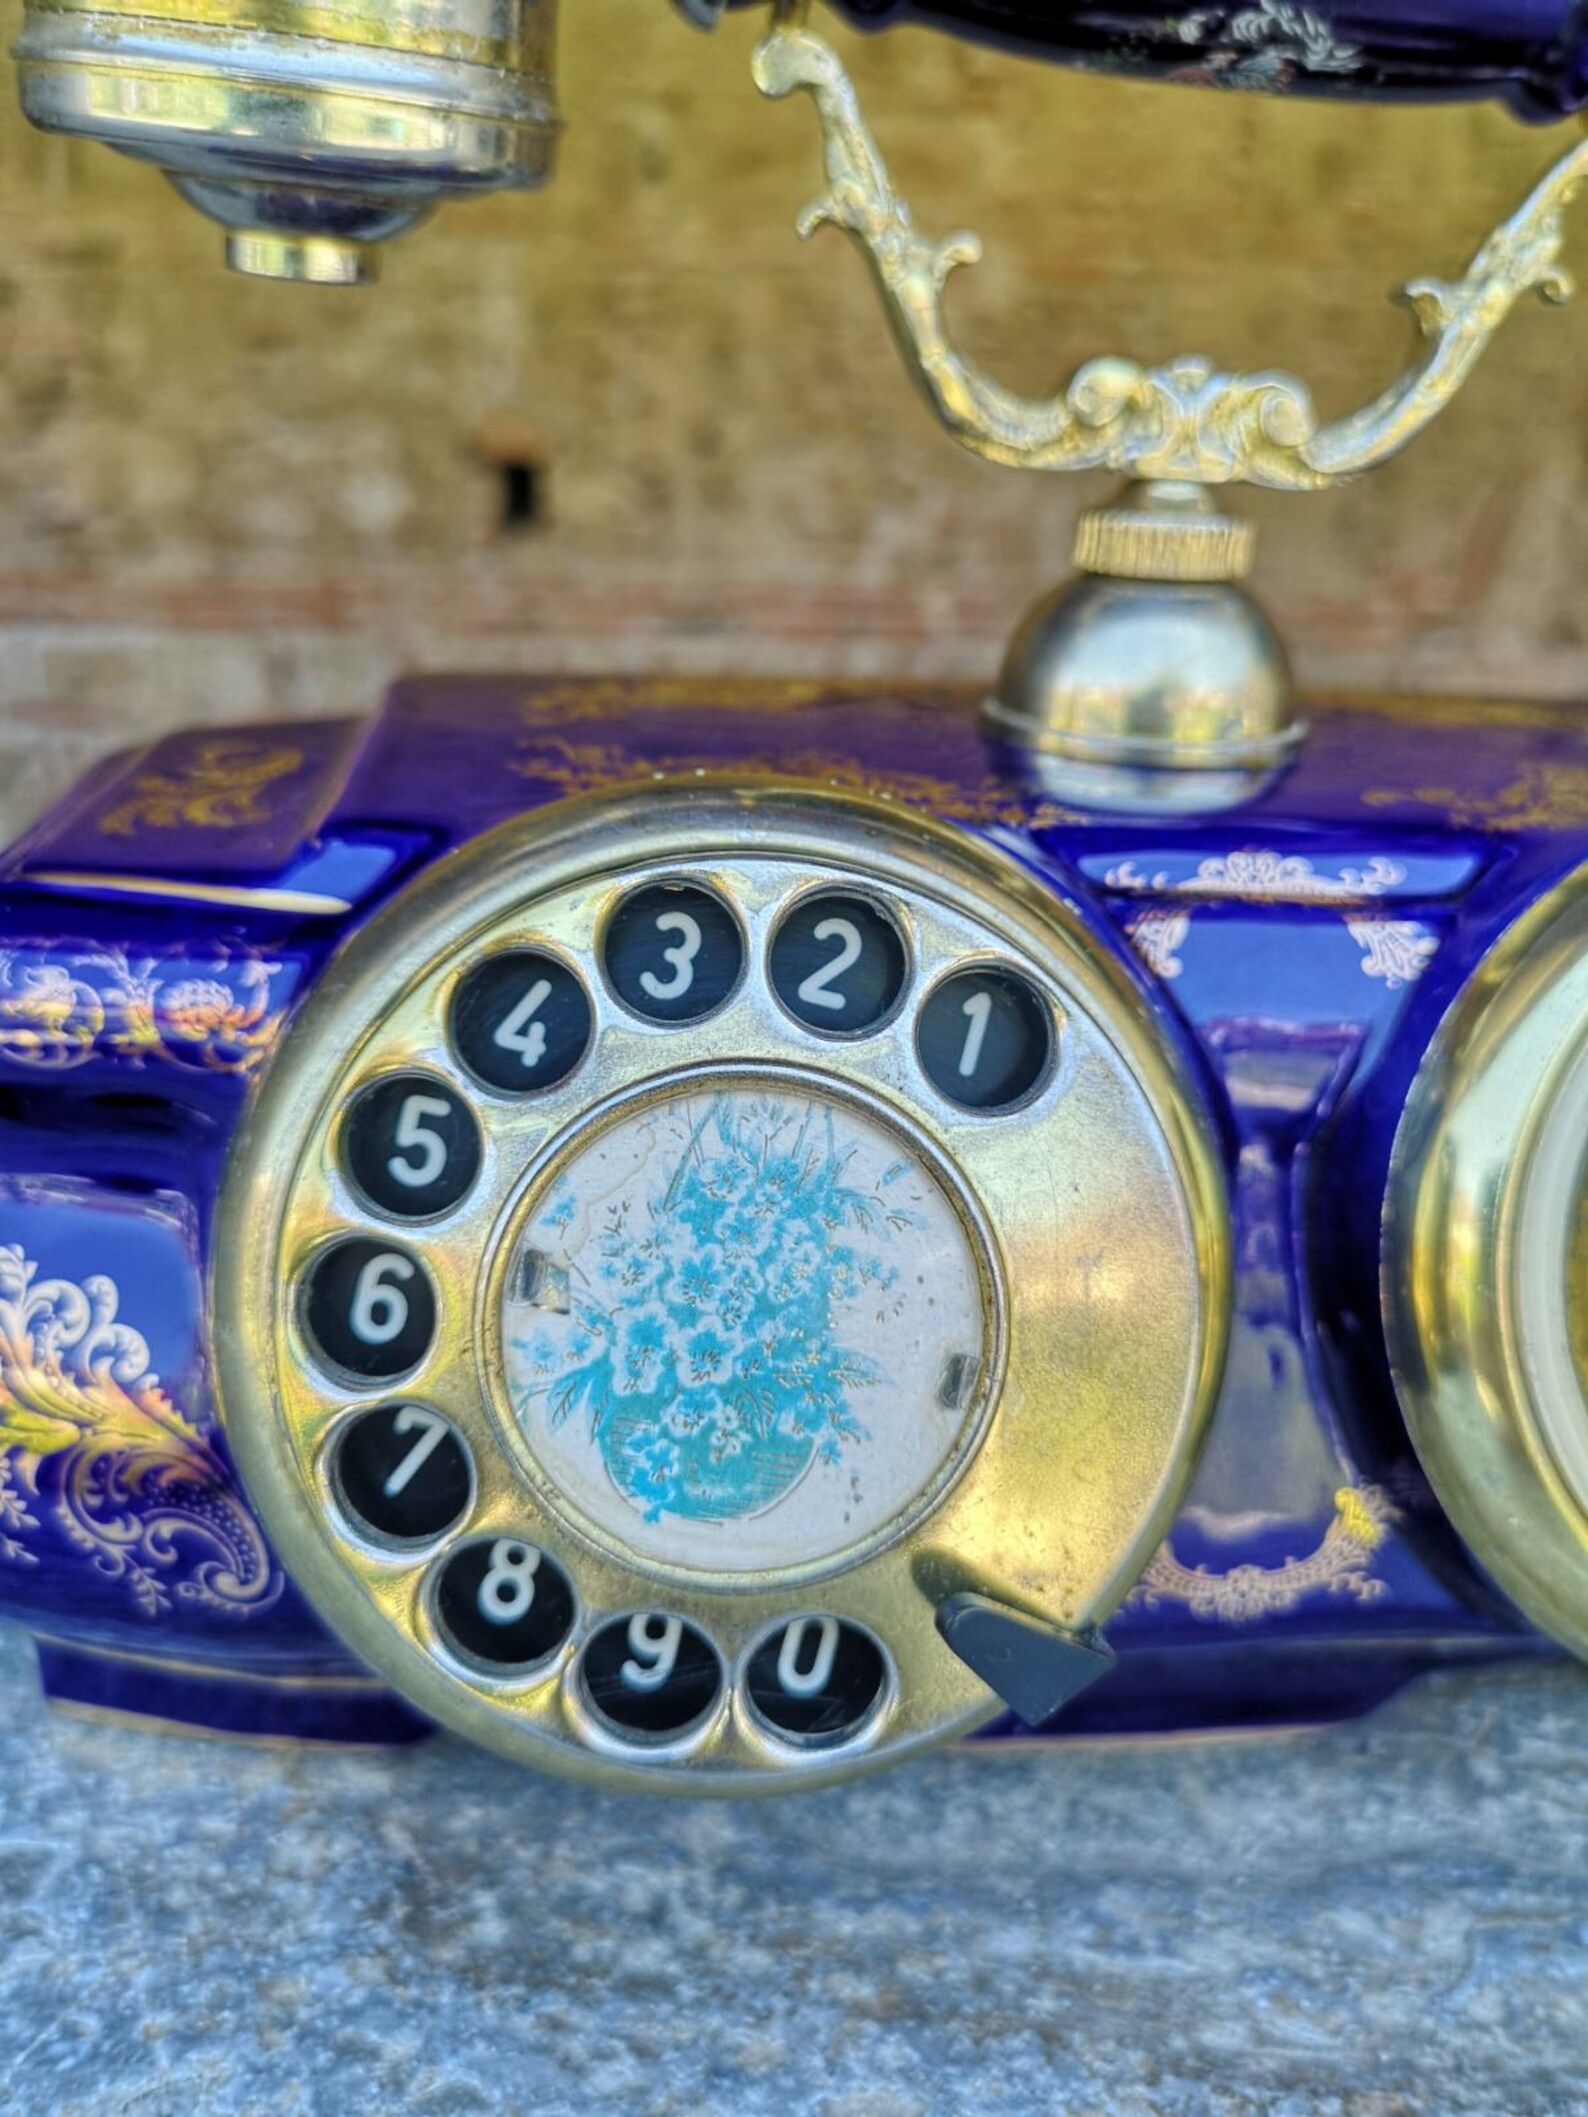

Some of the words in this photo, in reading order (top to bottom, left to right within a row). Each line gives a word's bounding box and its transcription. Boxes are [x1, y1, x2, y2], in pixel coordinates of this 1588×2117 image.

[640, 911, 701, 998] 3
[798, 918, 862, 1009] 2
[495, 980, 551, 1066] 4
[959, 992, 991, 1076] 1
[387, 1095, 451, 1186] 5
[353, 1253, 414, 1342] 6
[386, 1406, 448, 1497] 7
[480, 1539, 540, 1624] 8
[622, 1613, 682, 1689] 9
[778, 1616, 837, 1696] 0
